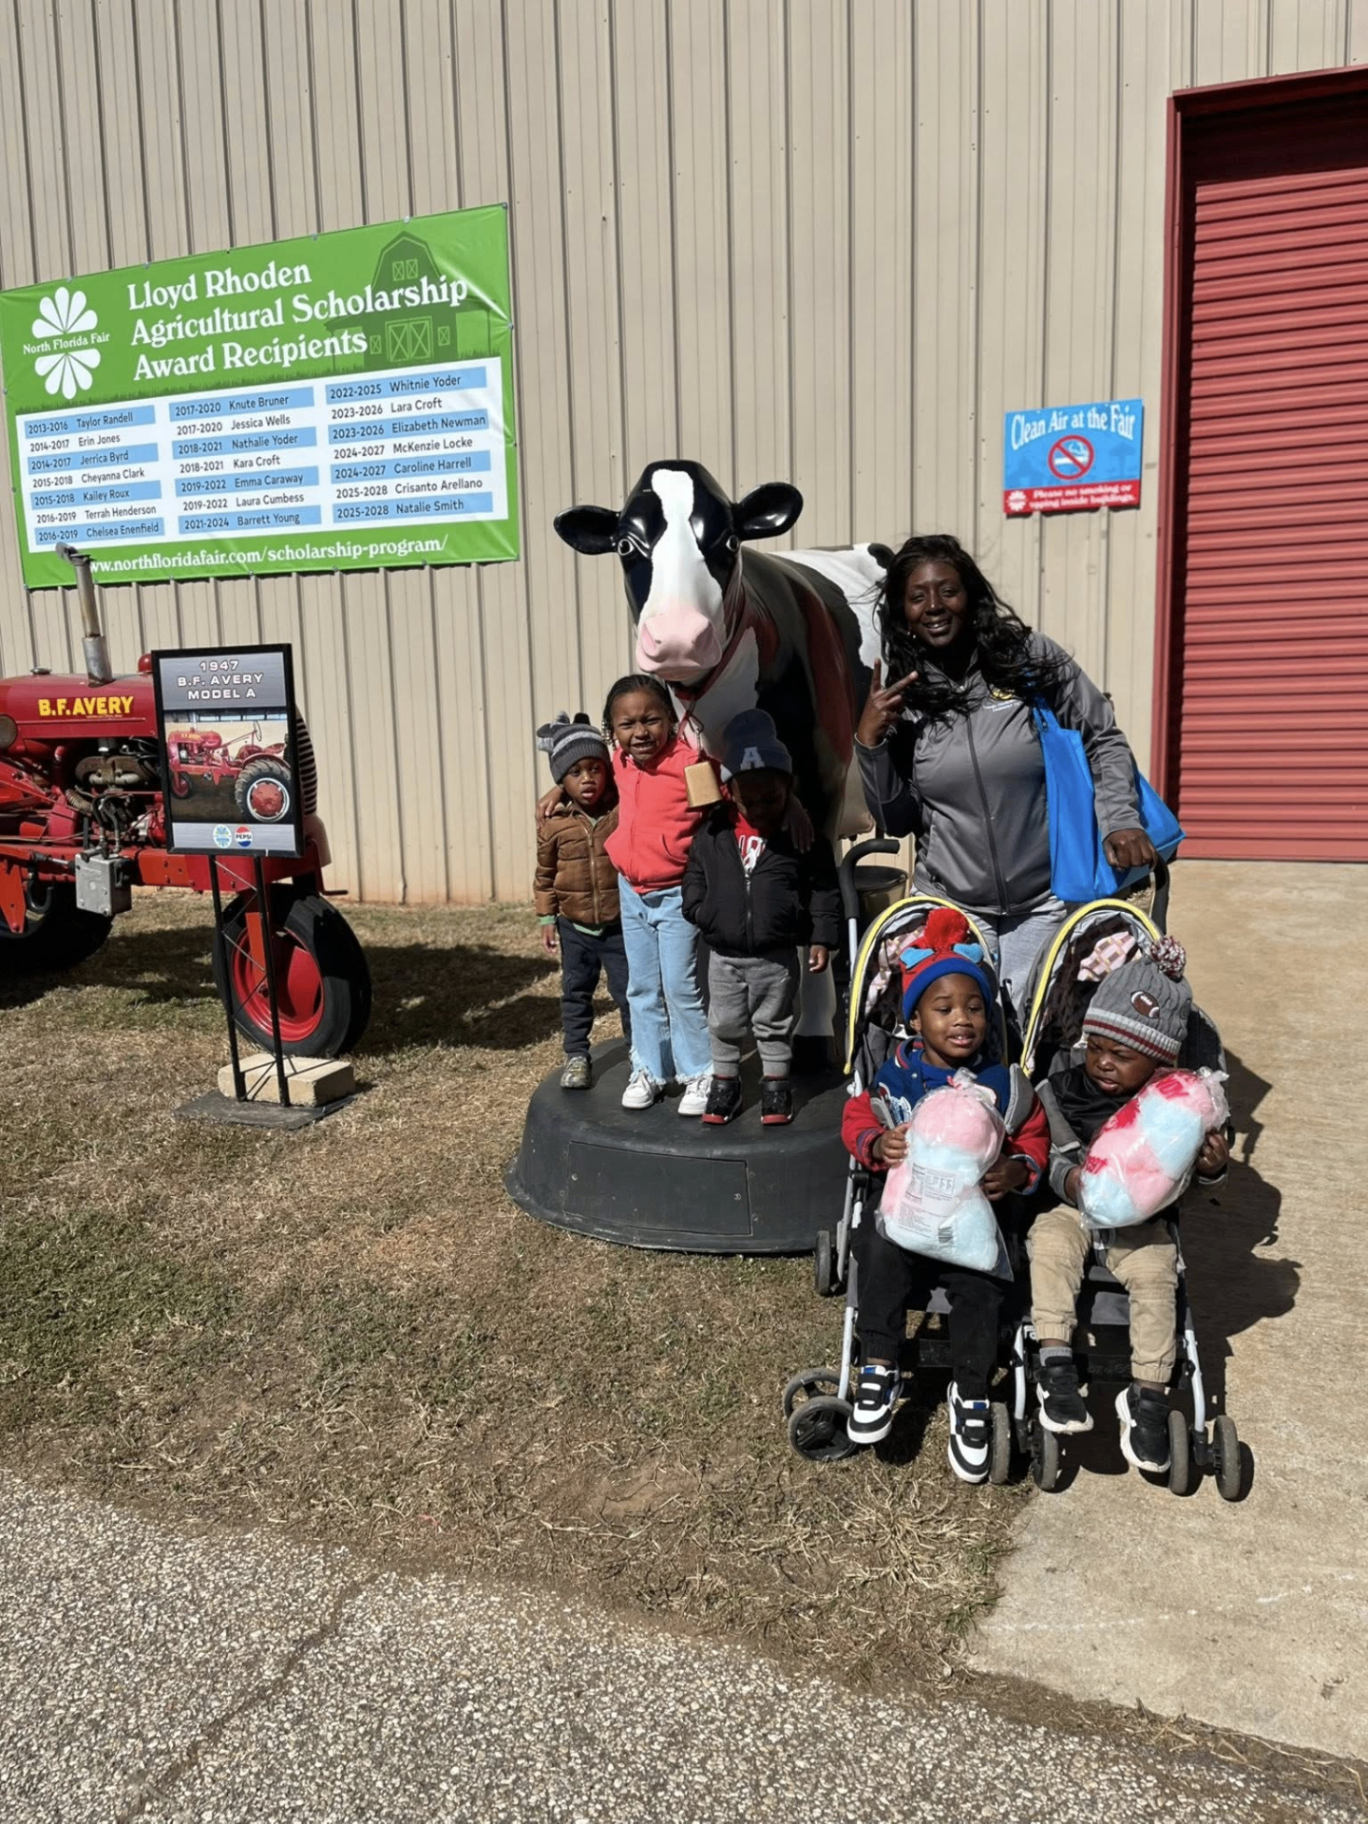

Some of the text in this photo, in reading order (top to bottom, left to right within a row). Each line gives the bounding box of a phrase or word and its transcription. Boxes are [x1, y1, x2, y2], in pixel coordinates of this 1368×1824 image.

[128, 260, 312, 310] Lloyd Rhoden
[131, 275, 468, 348] Agricultural Scholarship
[23, 332, 110, 355] North Florida Fair
[134, 329, 368, 381] Award Recipients
[331, 376, 461, 399] 2022-2025 Whitnie Yoder
[176, 396, 289, 416] 2017-2020 Knute Bruner
[332, 398, 442, 419] 2023-2026 Lara Croft
[29, 413, 133, 434] 2013-2016 Taylor Randell
[177, 414, 290, 435] 2017-2020 Jessica Wells
[333, 416, 485, 439] 2023-2026 Elizabeth Newman
[1011, 404, 1135, 450] Clean Air at the Fair
[30, 434, 120, 452] 2014-2017 Erin Jones
[178, 434, 298, 454] 2018-2021 Nathalie Yoder
[334, 437, 473, 459] 2024-2027 McKenzie Locke
[32, 451, 128, 470] 2014-2017 Jerrica Byrd
[180, 455, 280, 473] 2018-2021 Kara Croft
[335, 457, 471, 479] 2024-2027 Caroline Harrell
[33, 468, 145, 488] 2015-2018 Cheyanna Clark
[182, 474, 303, 492] 2019-2022 Emma Caraway
[35, 489, 129, 506] 2015-2018 Kailey Roux
[336, 478, 482, 499] 2025-2028 Crisanto Arellano
[183, 493, 304, 511] 2019-2022 Laura Cumbess
[338, 499, 464, 518] 2025-2028 Natalie Smith
[37, 506, 156, 524] 2016-2019 Terrah Henderson
[185, 514, 300, 529] 2021-2024 Barrett Young
[39, 523, 158, 541] 2016-2019 Chelsea Enenfield
[90, 534, 448, 572] ww.northfloridafair.com/scholarship-program/
[200, 661, 239, 671] 1947
[178, 674, 262, 686] B.F. AVERY
[188, 689, 256, 700] MODEL A
[741, 746, 765, 770] A
